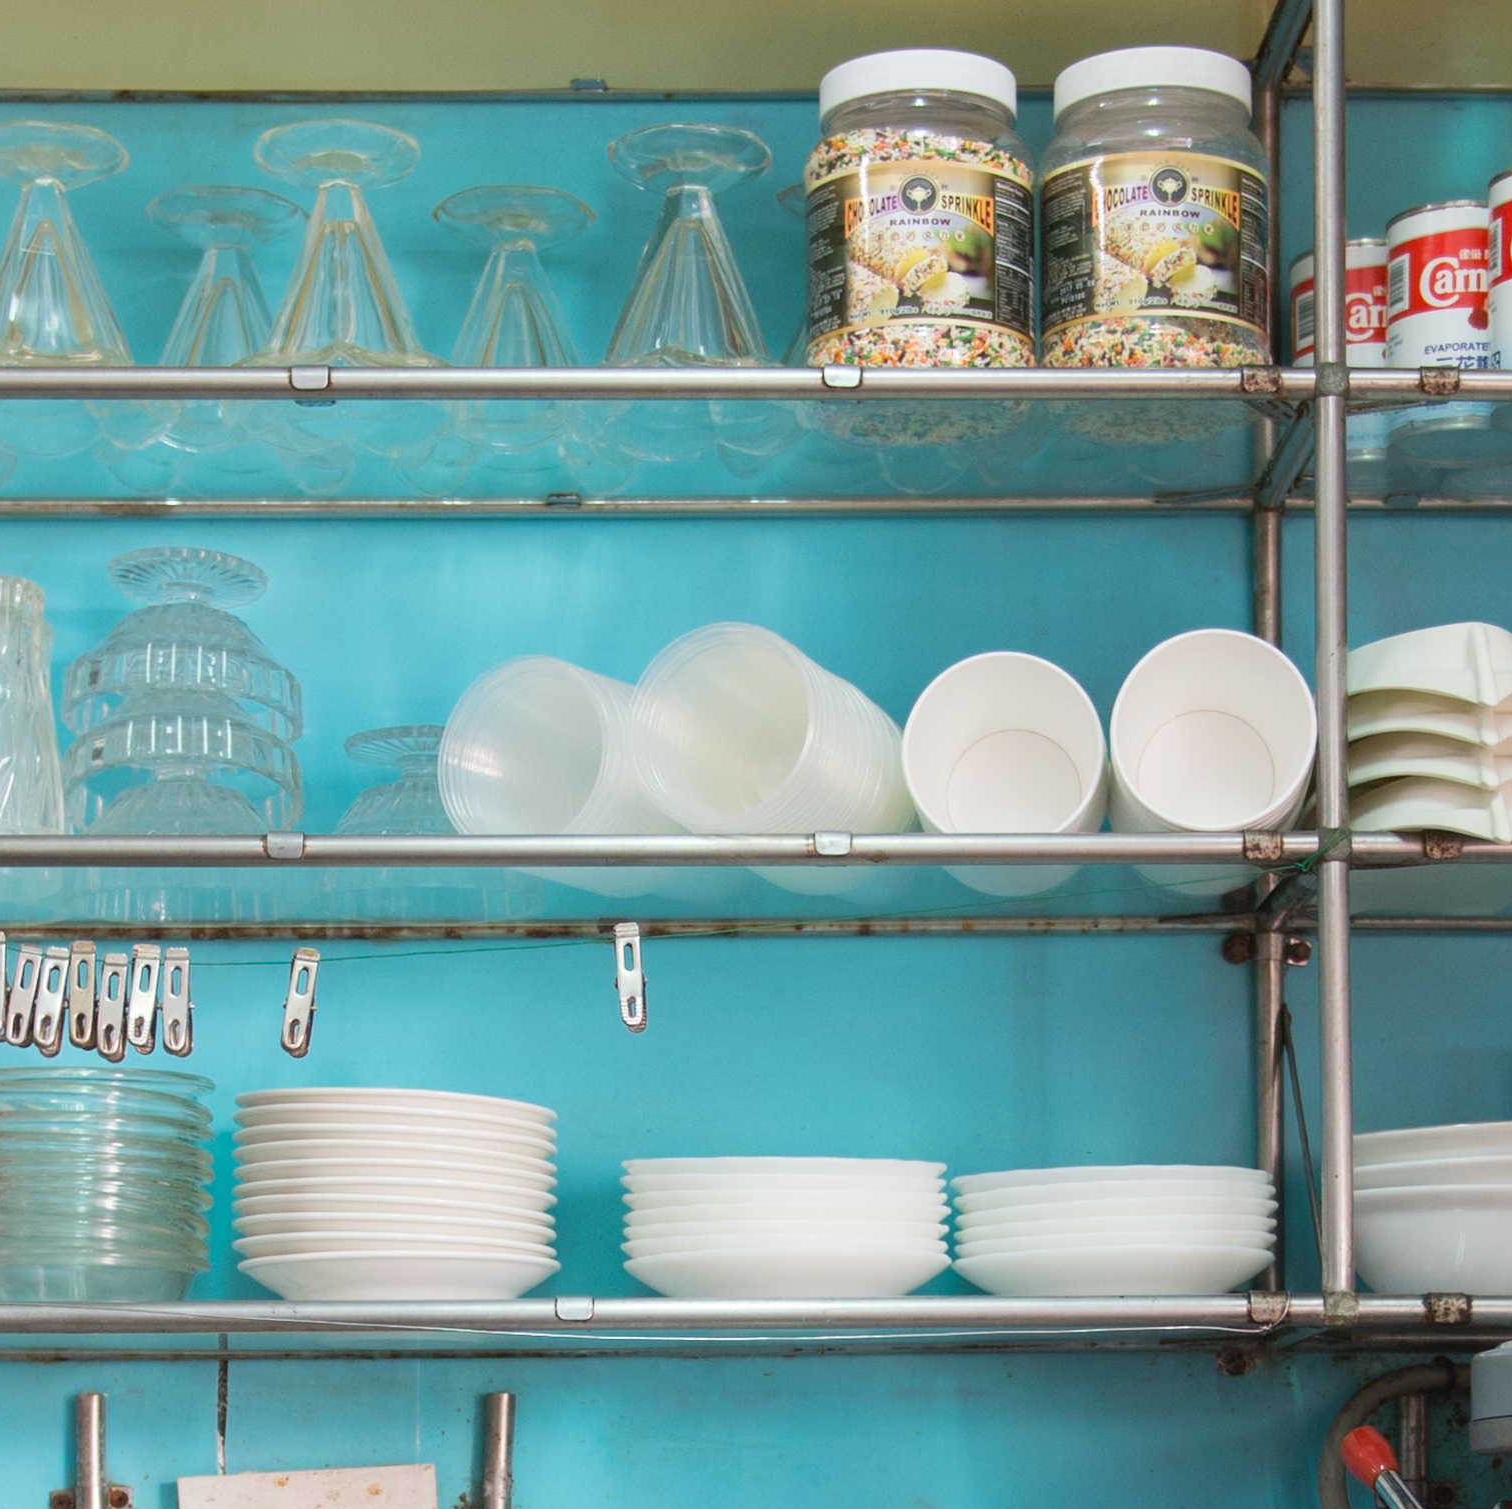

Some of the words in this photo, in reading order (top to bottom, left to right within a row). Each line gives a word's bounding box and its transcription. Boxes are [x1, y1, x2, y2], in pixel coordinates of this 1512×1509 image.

[941, 194, 992, 230] SPRINKLE
[1140, 210, 1200, 218] RAINBOW
[1191, 187, 1237, 223] SPRINKLE
[890, 218, 951, 226] RAINBOW
